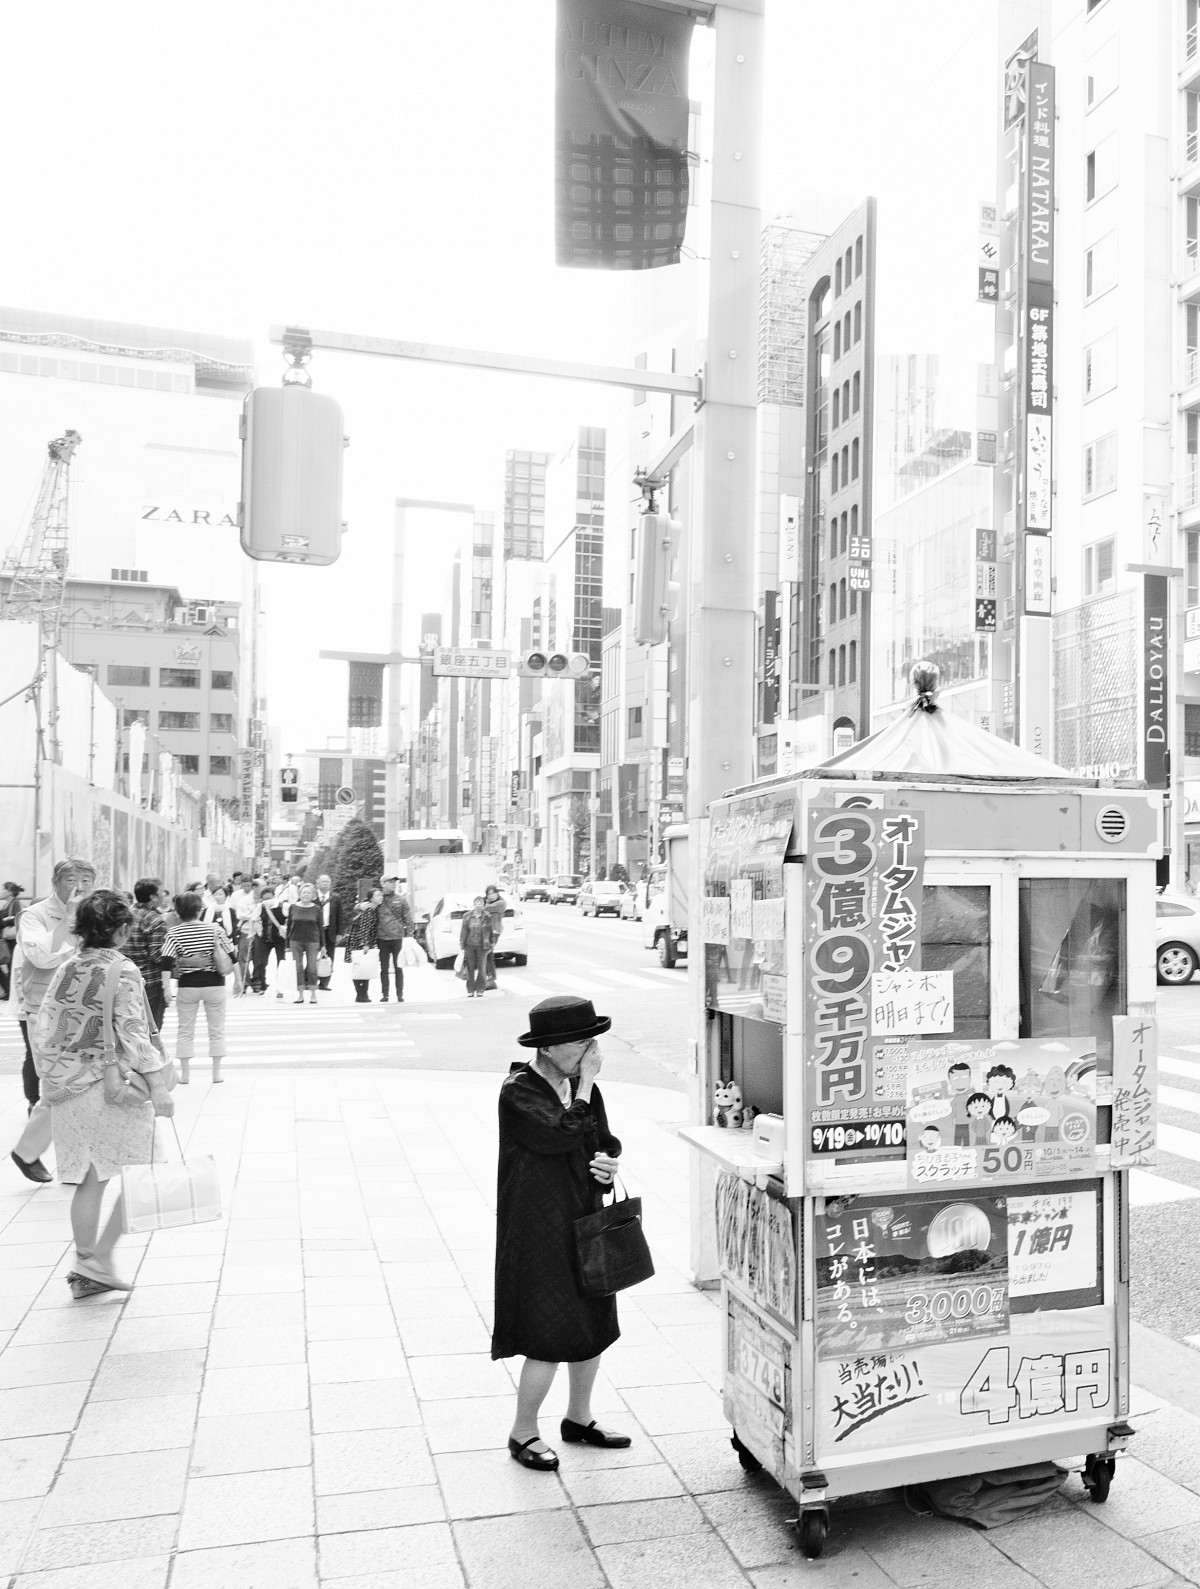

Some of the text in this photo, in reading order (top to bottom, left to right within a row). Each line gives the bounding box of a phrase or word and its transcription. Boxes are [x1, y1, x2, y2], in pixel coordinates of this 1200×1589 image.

[1032, 82, 1050, 265] インド料理 NATARAJ
[1030, 308, 1049, 321] 6F
[142, 505, 238, 527] ZARA
[850, 566, 869, 578] UNI
[850, 578, 871, 590] QLO
[440, 654, 507, 668] 銀座五丁目
[1146, 614, 1166, 743] DALLOYAU
[876, 973, 943, 994] ジャンボ
[1129, 1022, 1155, 1166] オータムジャンボ
[1113, 1087, 1131, 1156] 発売中
[917, 1162, 973, 1178] スクラッチ
[1013, 1224, 1074, 1257] 1億円
[826, 1223, 859, 1330] コレがある。
[852, 1217, 884, 1317] 日本には、
[830, 1361, 924, 1428] 大当たり!
[960, 1346, 1112, 1425] 4億円
